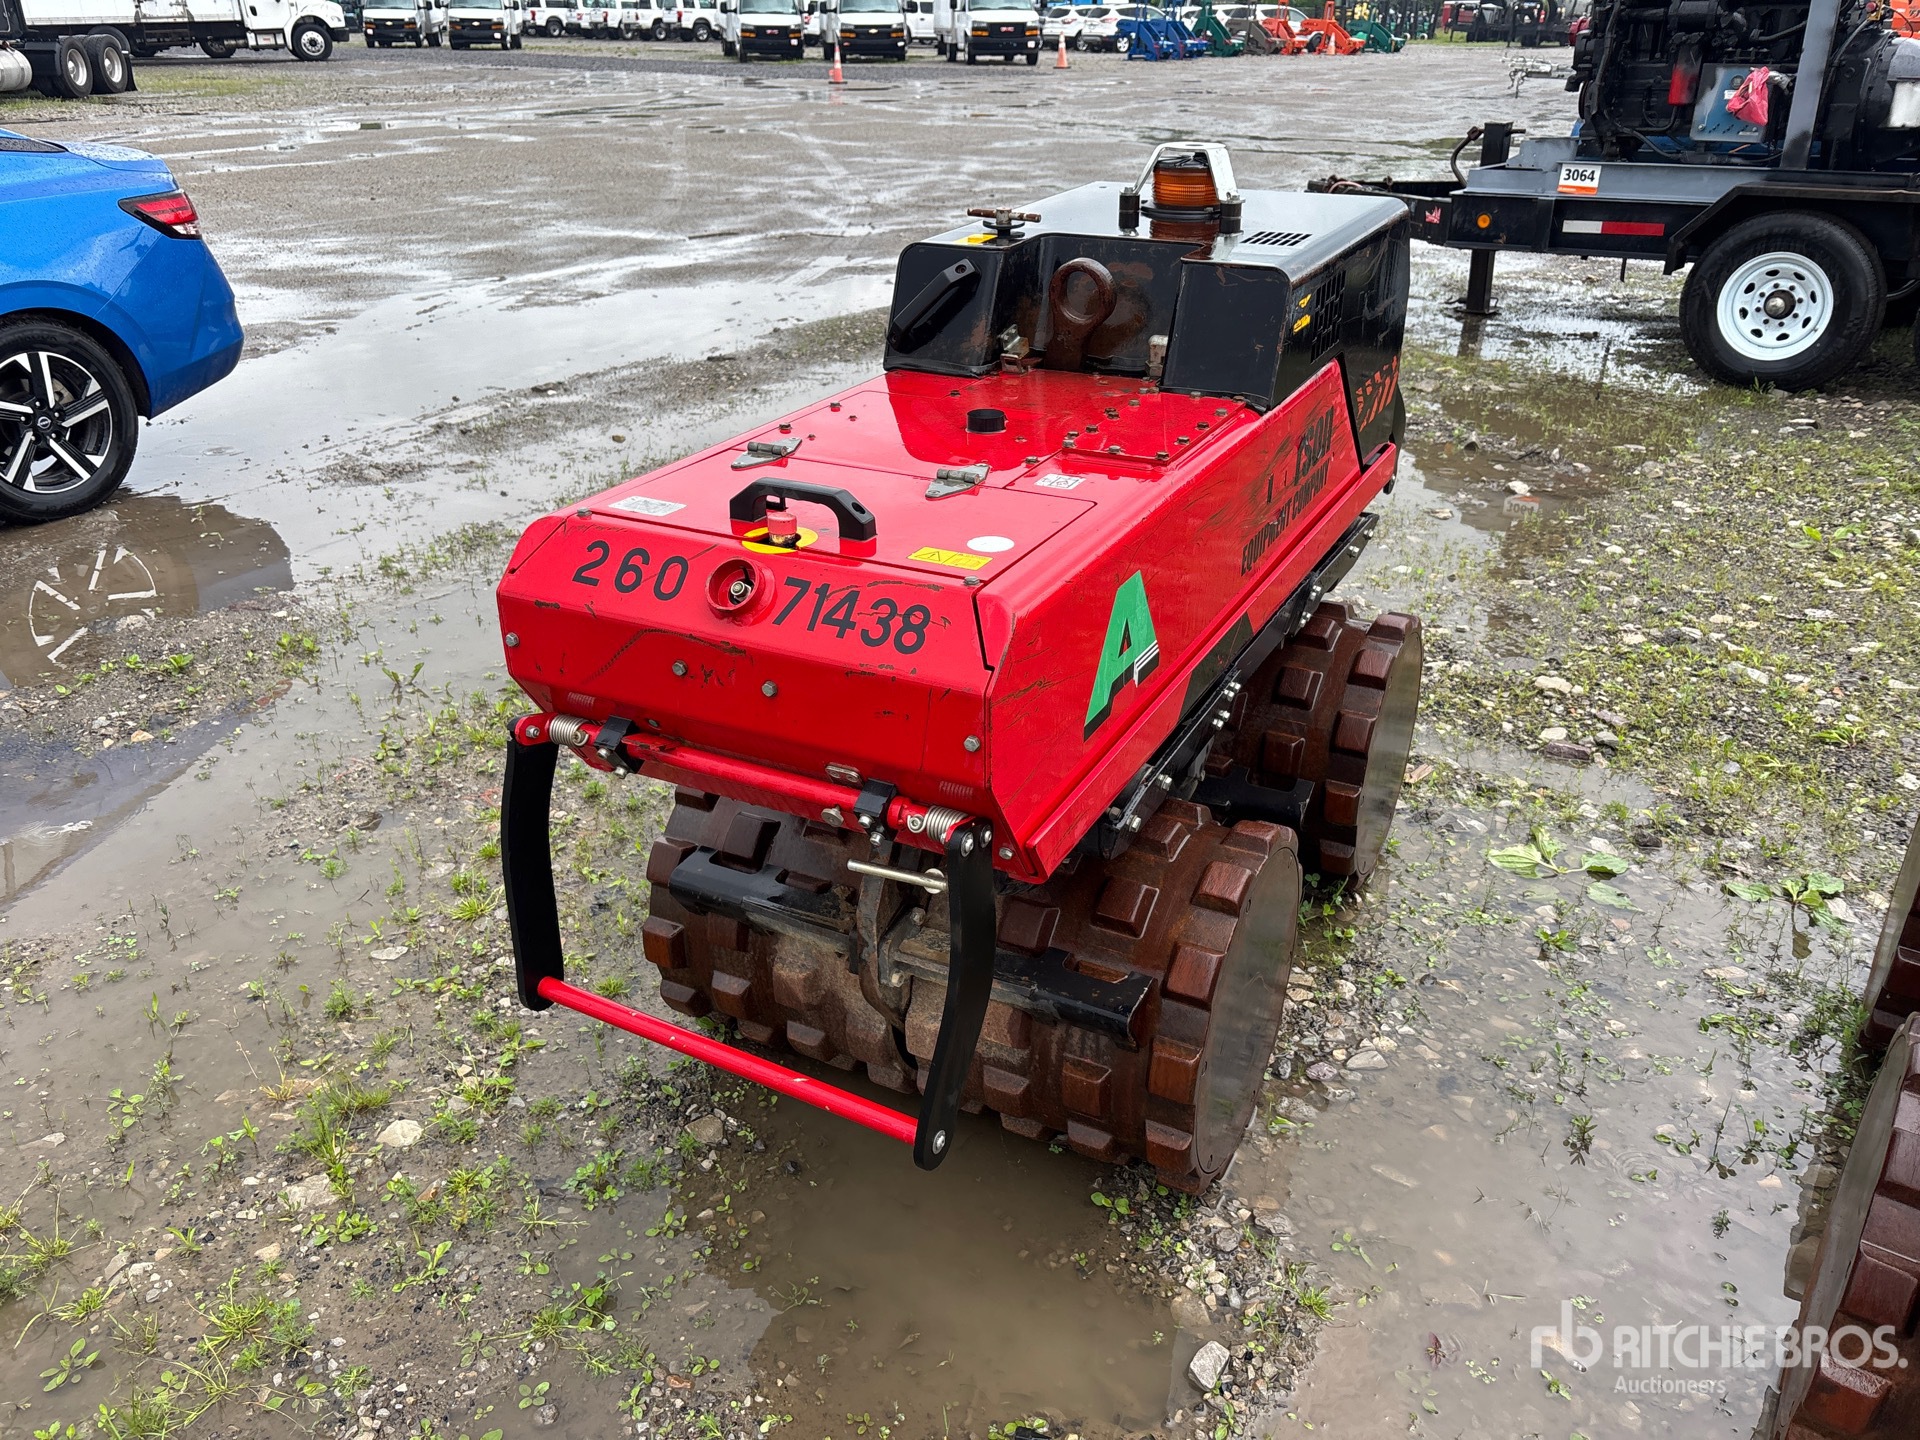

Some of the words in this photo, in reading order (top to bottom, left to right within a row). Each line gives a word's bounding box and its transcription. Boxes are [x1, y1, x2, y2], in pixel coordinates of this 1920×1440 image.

[1563, 168, 1596, 182] 3064
[572, 540, 690, 601] 260
[772, 576, 932, 655] 71438
